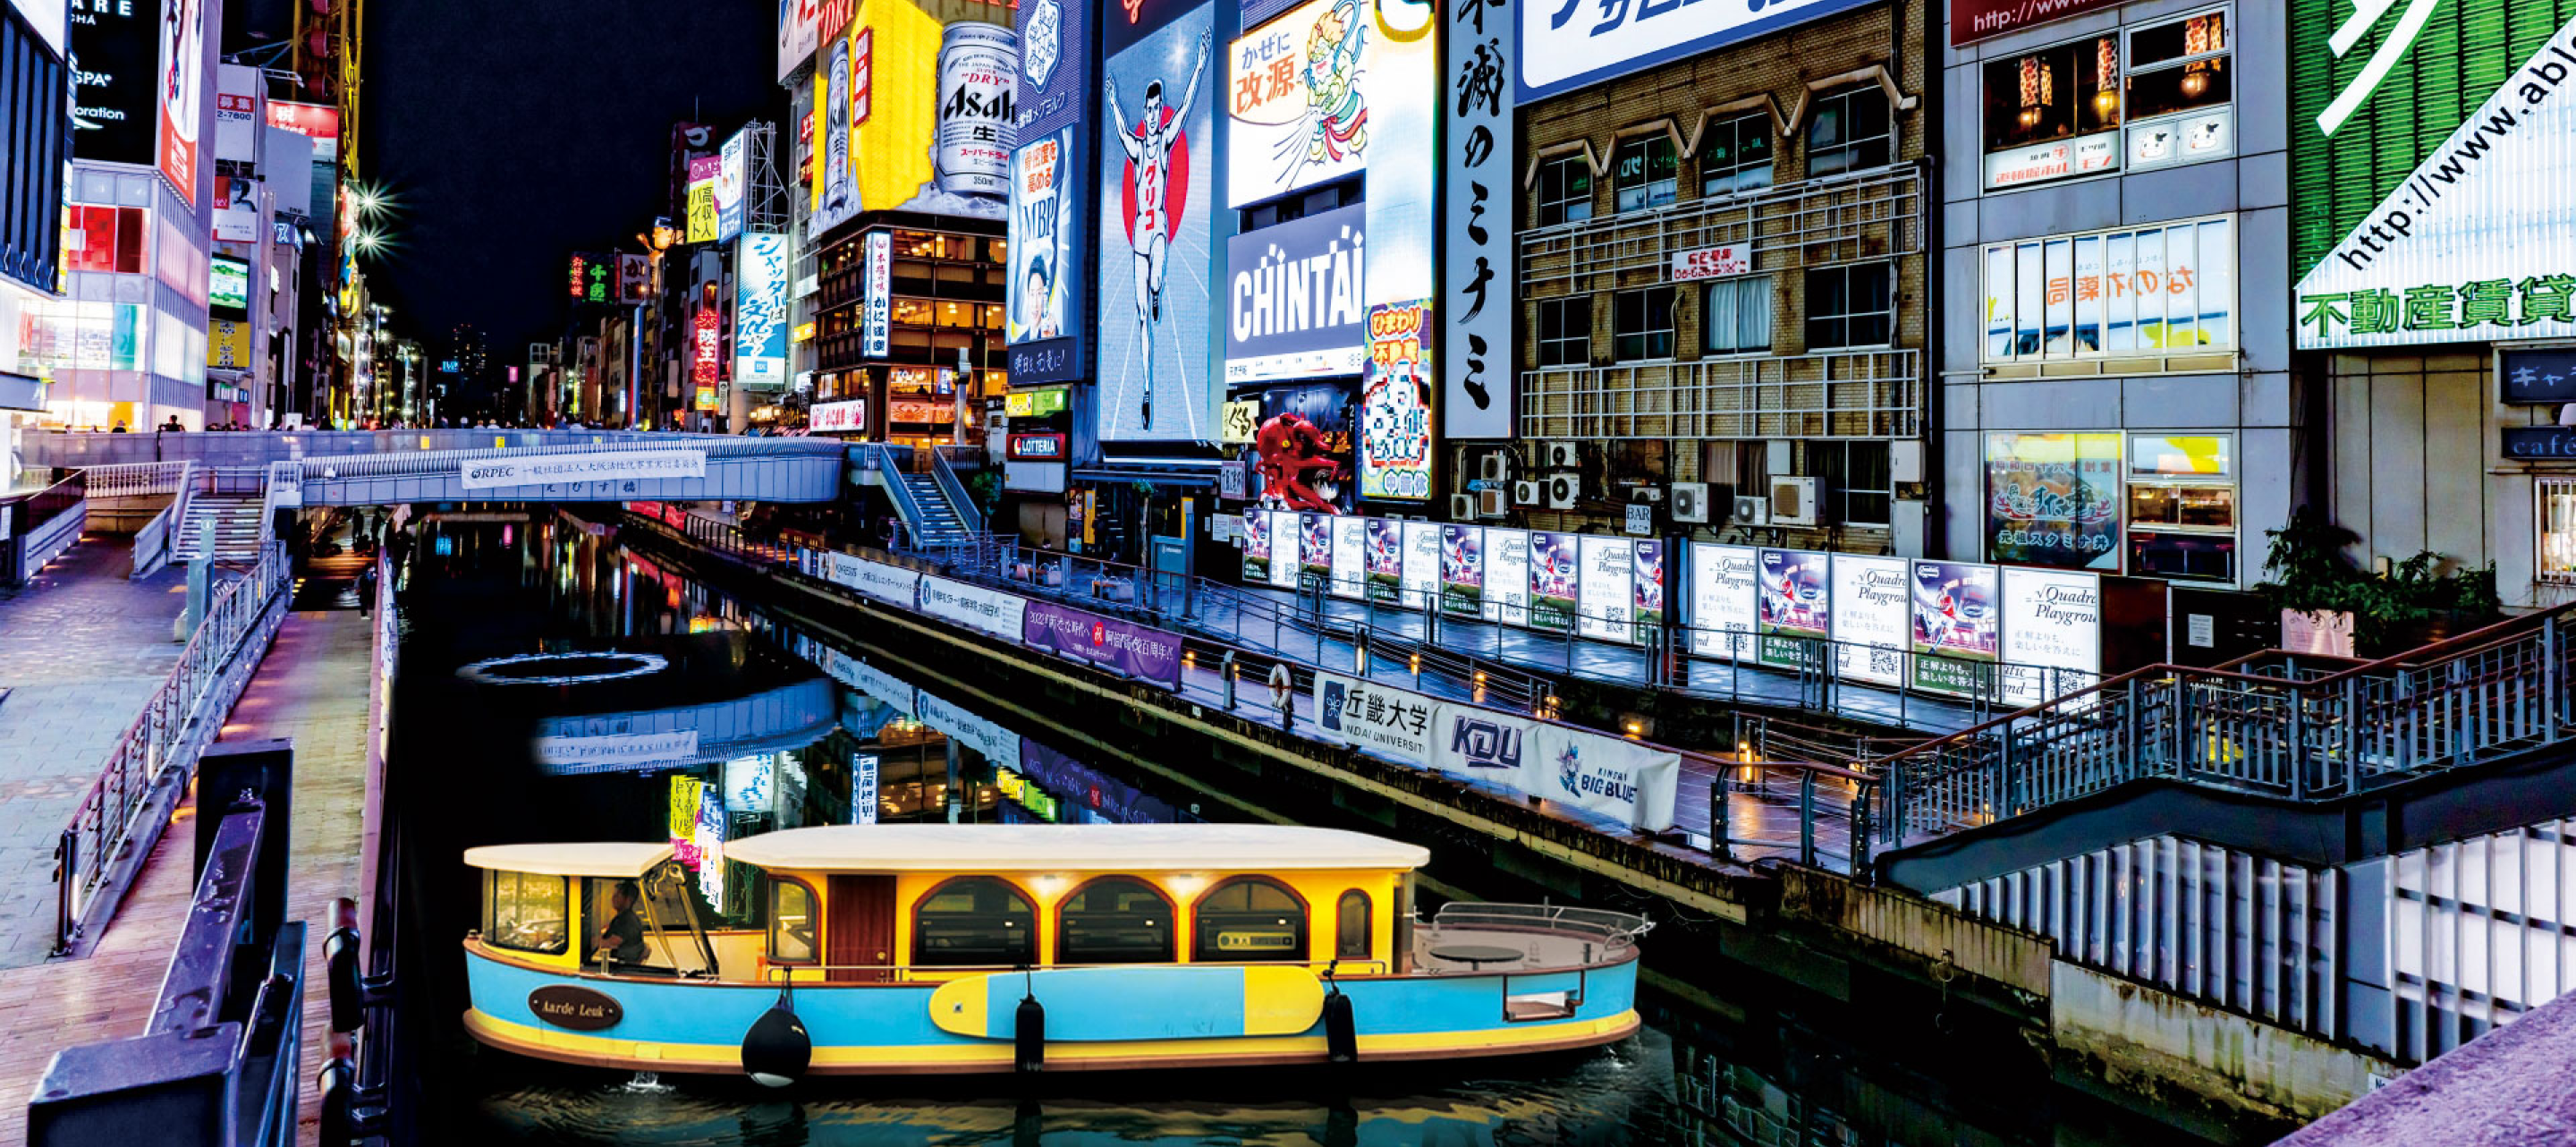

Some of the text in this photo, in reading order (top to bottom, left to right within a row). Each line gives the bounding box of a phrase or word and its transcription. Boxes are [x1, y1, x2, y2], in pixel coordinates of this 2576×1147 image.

[1241, 32, 1292, 70] かぜに
[1235, 52, 1296, 115] 改源
[944, 83, 1016, 125] Asah
[972, 125, 996, 142] 生
[2337, 39, 2576, 271] http://www.abl
[1144, 160, 1158, 232] グリコ
[1023, 196, 1055, 243] MBP
[1233, 225, 1364, 343] CHINTAI
[1371, 305, 1423, 338] ひまわり
[2300, 273, 2576, 338] 不動産賃貸
[1021, 438, 1055, 454] LOTTERIA
[1626, 506, 1650, 522] BAR
[1998, 530, 2110, 550] 元祖スタミナ丼
[1343, 689, 1428, 736] 近畿大学
[1373, 731, 1426, 756] UNIVERSIT
[1451, 715, 1522, 768] KDU
[1580, 774, 1639, 804] BIG BLUE
[1597, 766, 1629, 781] KINDAI
[579, 1003, 606, 1018] Leuk
